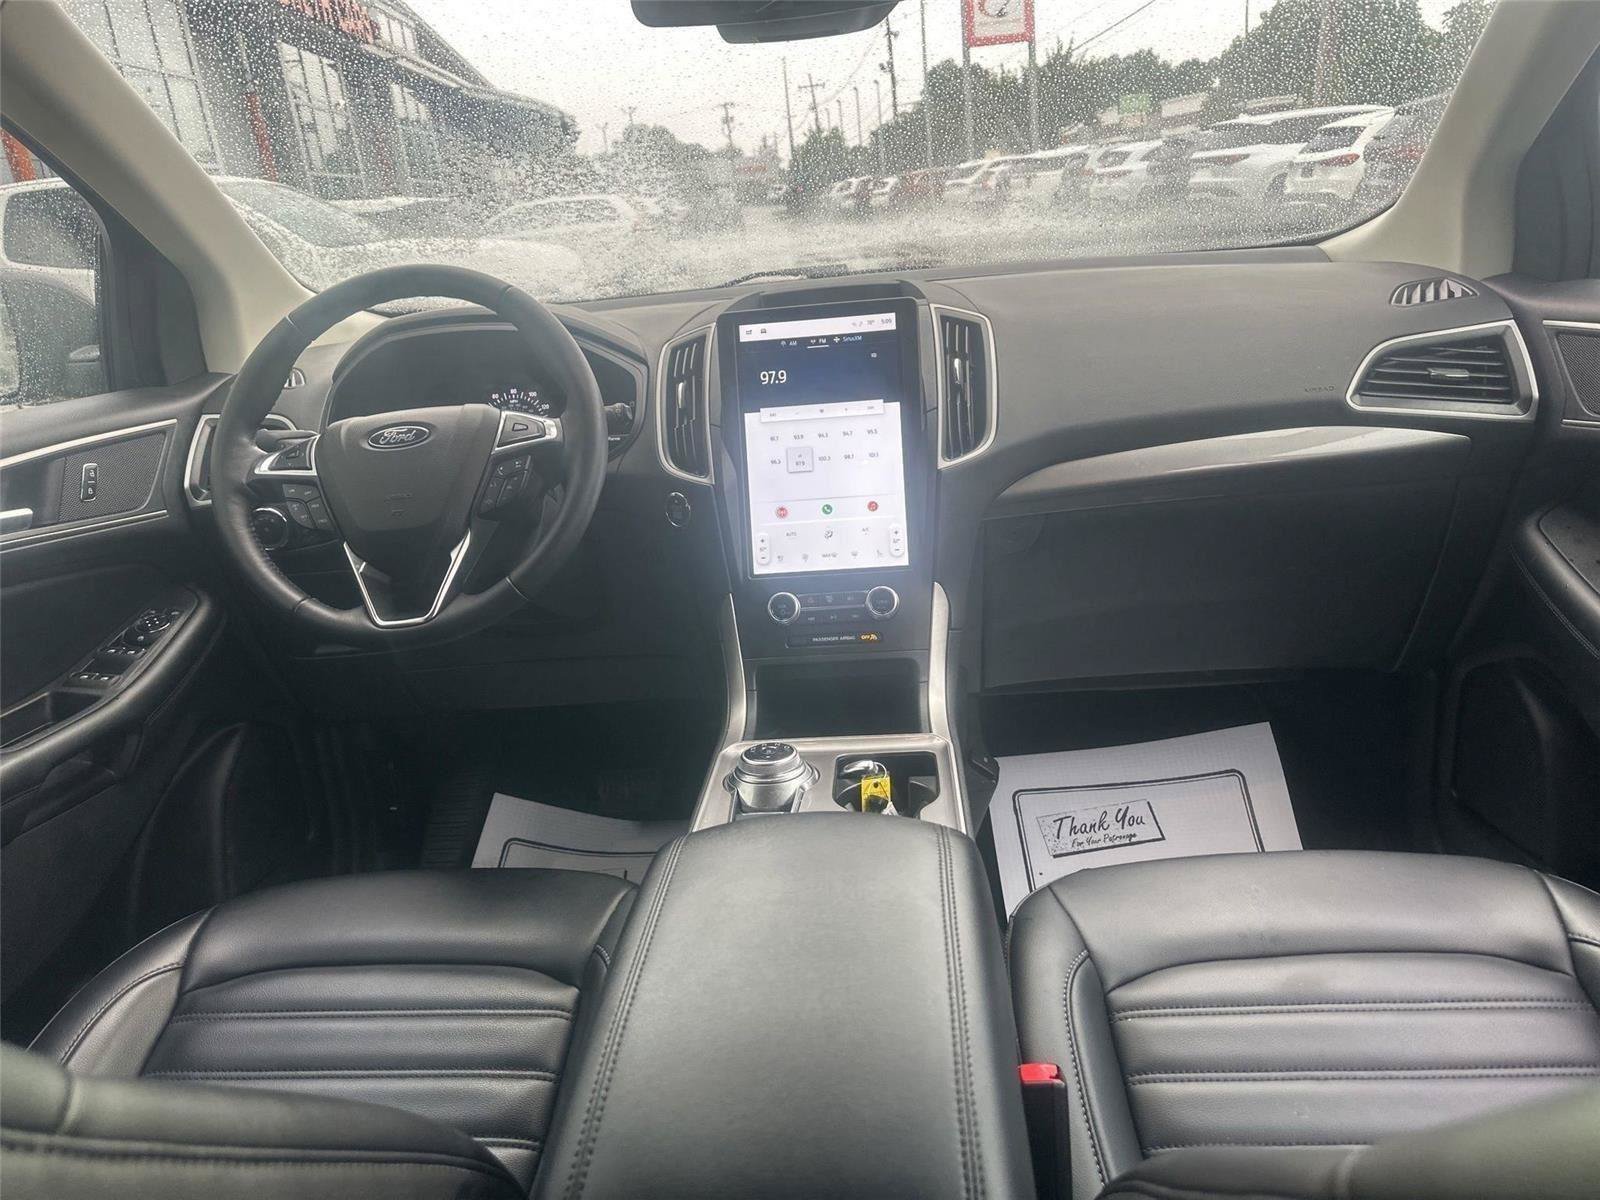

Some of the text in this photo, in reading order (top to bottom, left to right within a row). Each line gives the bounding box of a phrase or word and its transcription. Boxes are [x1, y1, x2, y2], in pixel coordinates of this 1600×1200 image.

[760, 370, 787, 385] 97.9
[379, 428, 417, 444] Ford
[1053, 806, 1146, 839] Thank You
[1071, 833, 1138, 848] For Your Patronage
